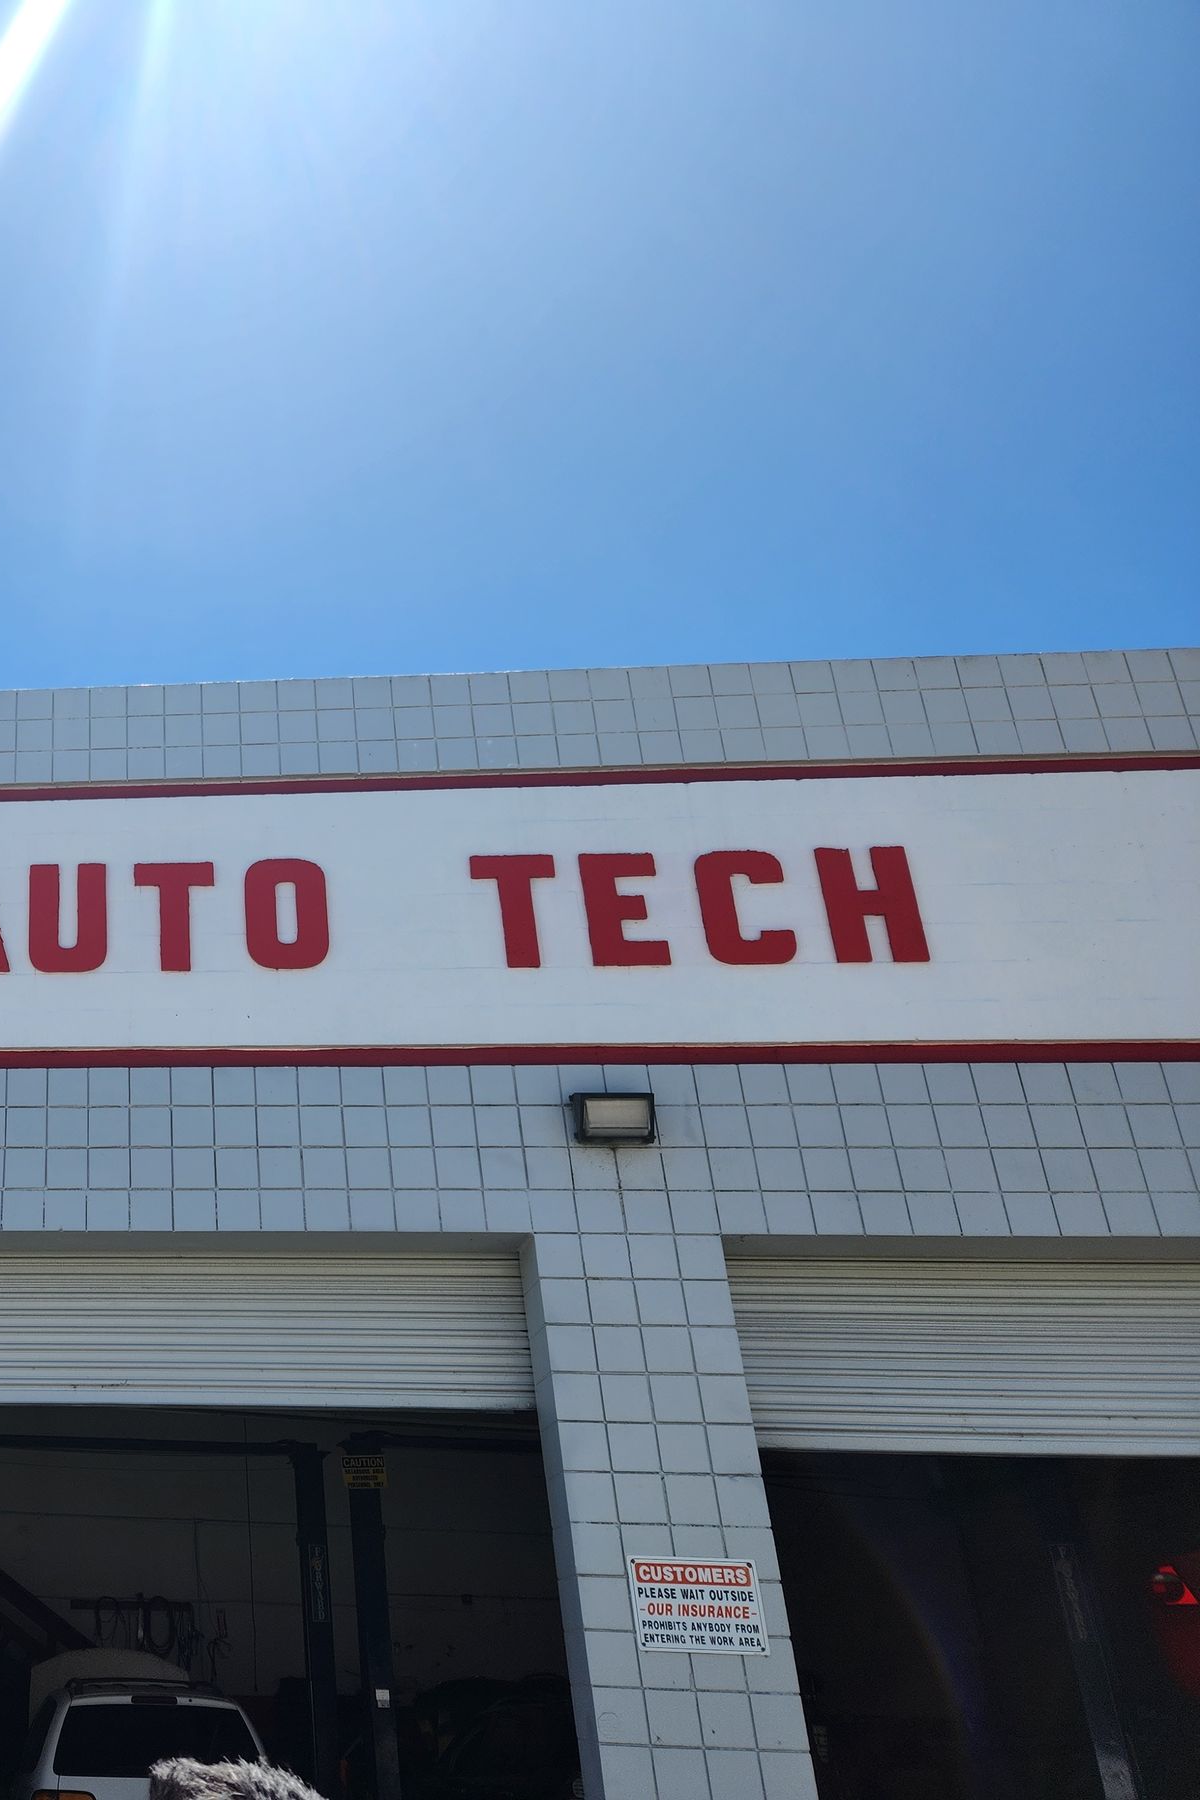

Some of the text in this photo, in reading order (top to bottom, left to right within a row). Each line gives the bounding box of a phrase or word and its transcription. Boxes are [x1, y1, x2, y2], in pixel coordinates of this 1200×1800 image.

[470, 846, 929, 967] TECH
[343, 1457, 384, 1467] CAUTION
[638, 1565, 748, 1584] CUSTOMERS
[638, 1587, 754, 1602] PLEASE WAIT OUTSIDE
[642, 1620, 760, 1634] PROHIBITS ANYBODY FROM
[644, 1633, 762, 1648] ENTERING THE WORK AREA
